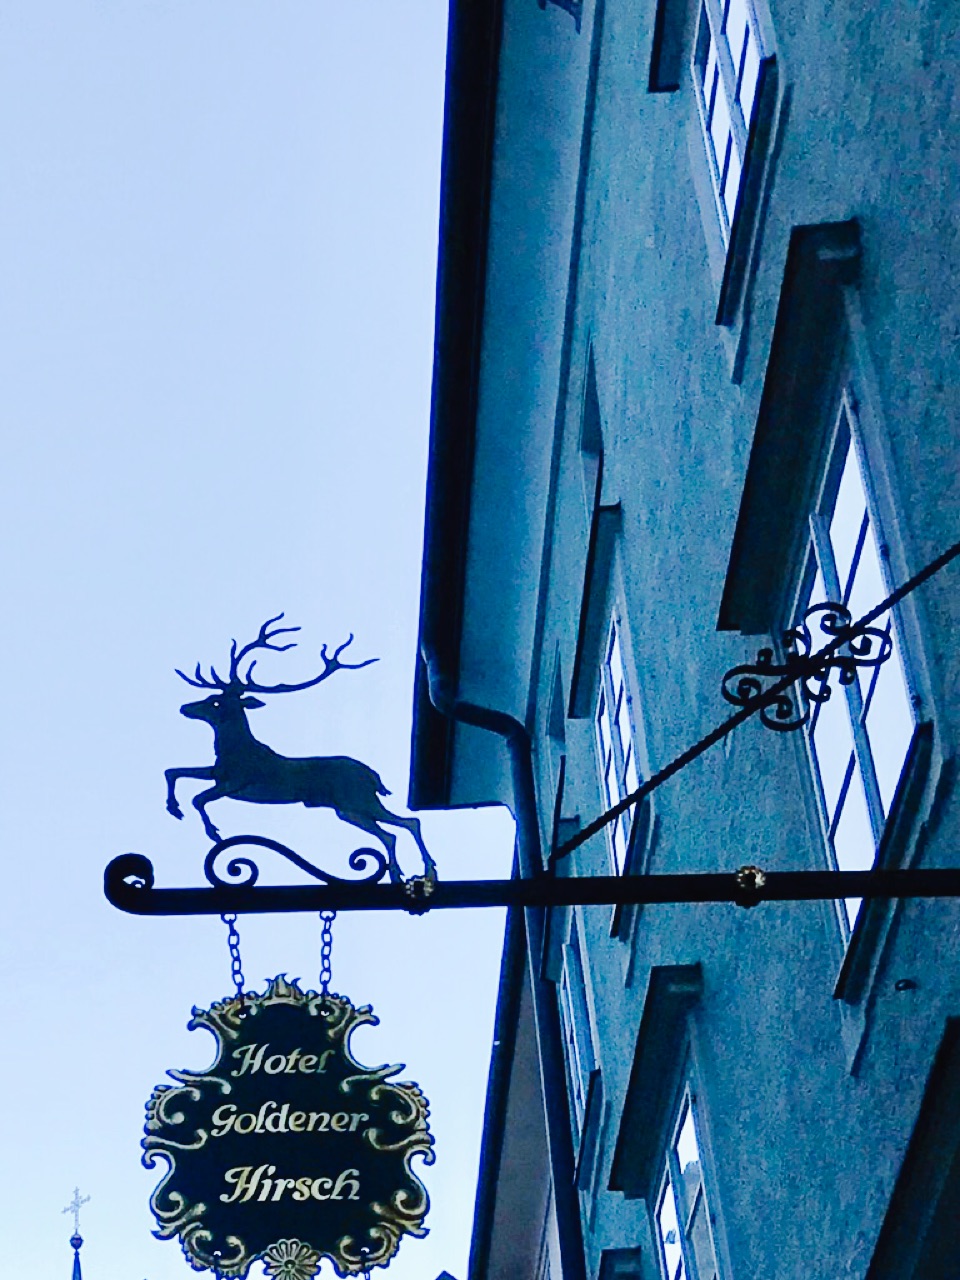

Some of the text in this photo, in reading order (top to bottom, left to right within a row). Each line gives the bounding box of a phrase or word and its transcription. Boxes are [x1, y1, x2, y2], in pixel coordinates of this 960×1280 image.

[231, 1043, 336, 1077] Hotel
[210, 1101, 370, 1137] Goldener
[219, 1164, 361, 1204] Hirsch
